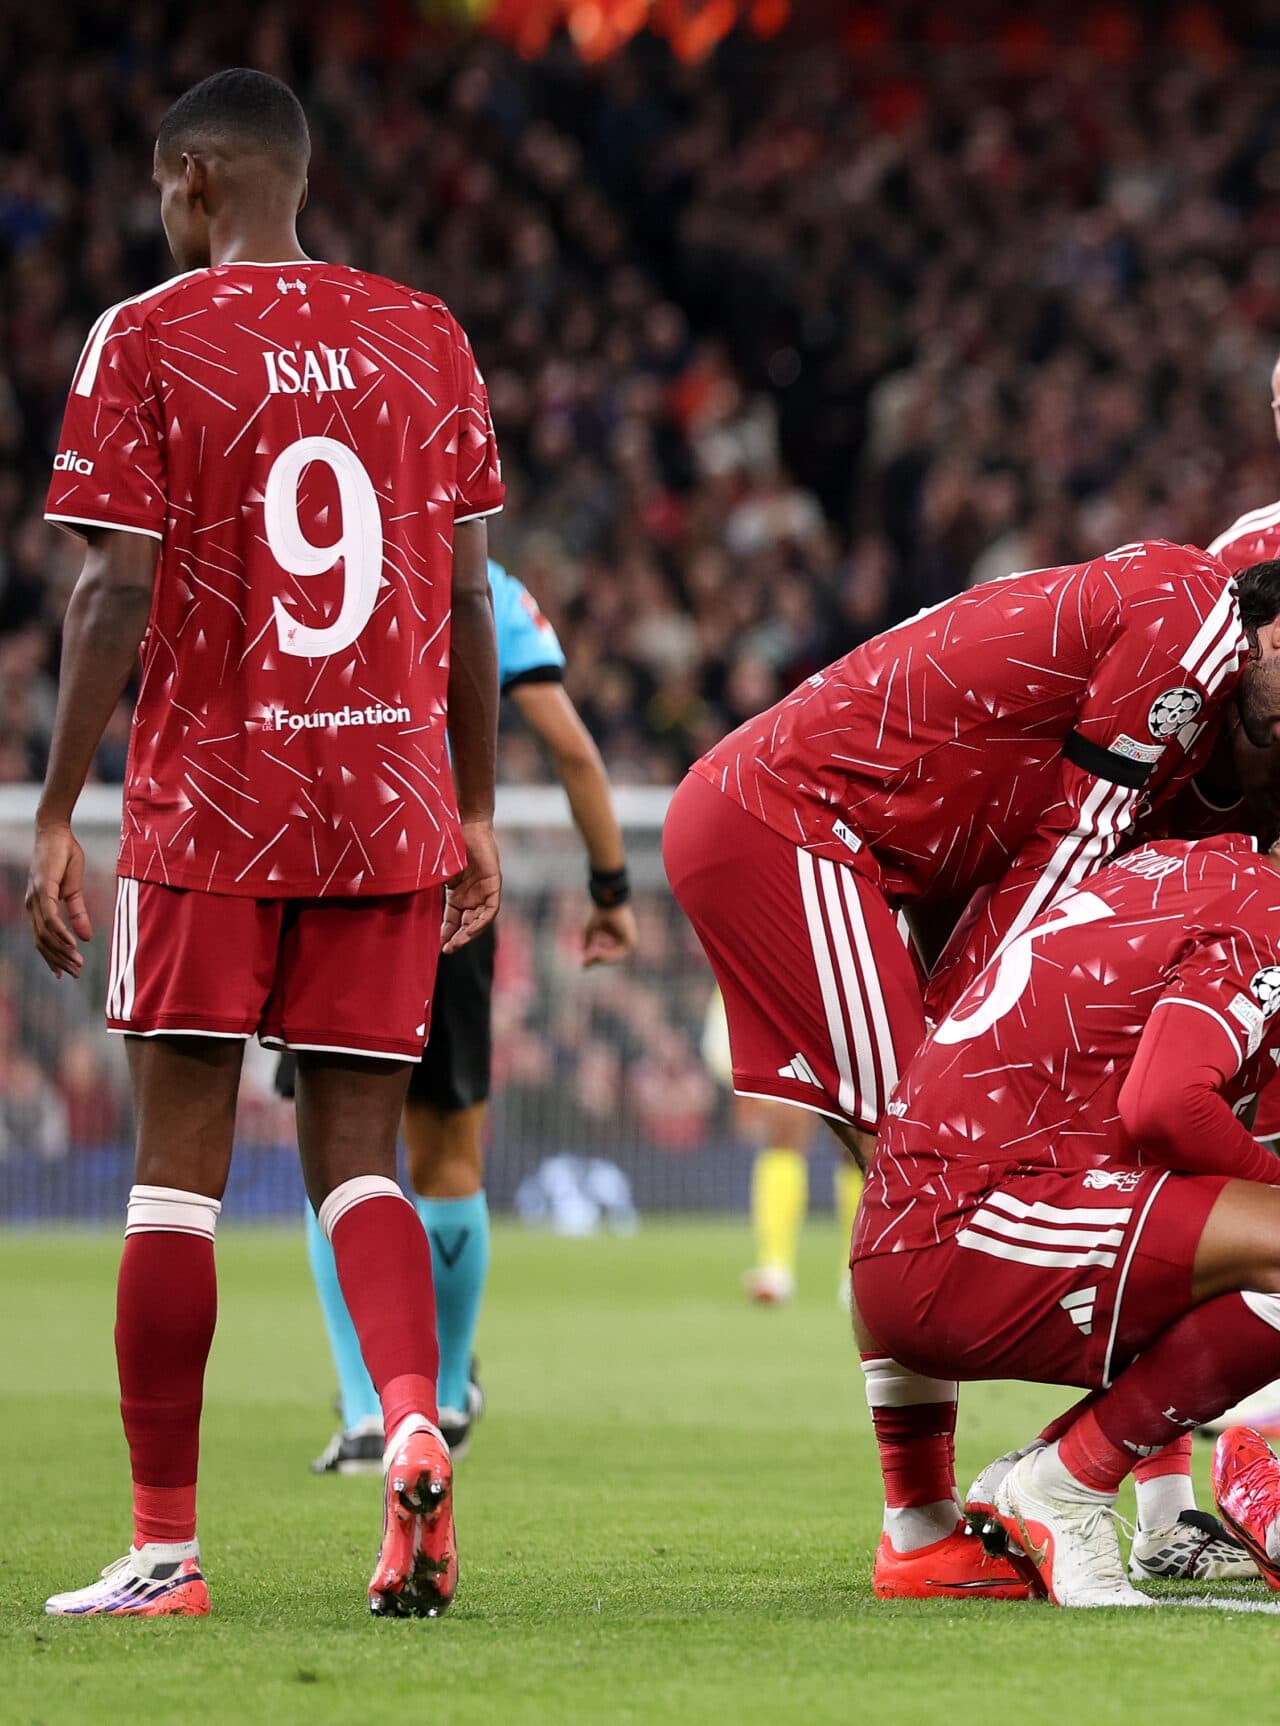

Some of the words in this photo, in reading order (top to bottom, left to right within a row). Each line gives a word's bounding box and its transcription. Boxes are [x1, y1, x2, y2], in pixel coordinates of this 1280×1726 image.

[262, 347, 357, 395] ISAK
[53, 449, 95, 476] dia
[264, 436, 383, 658] 9
[275, 703, 411, 731] Foundation
